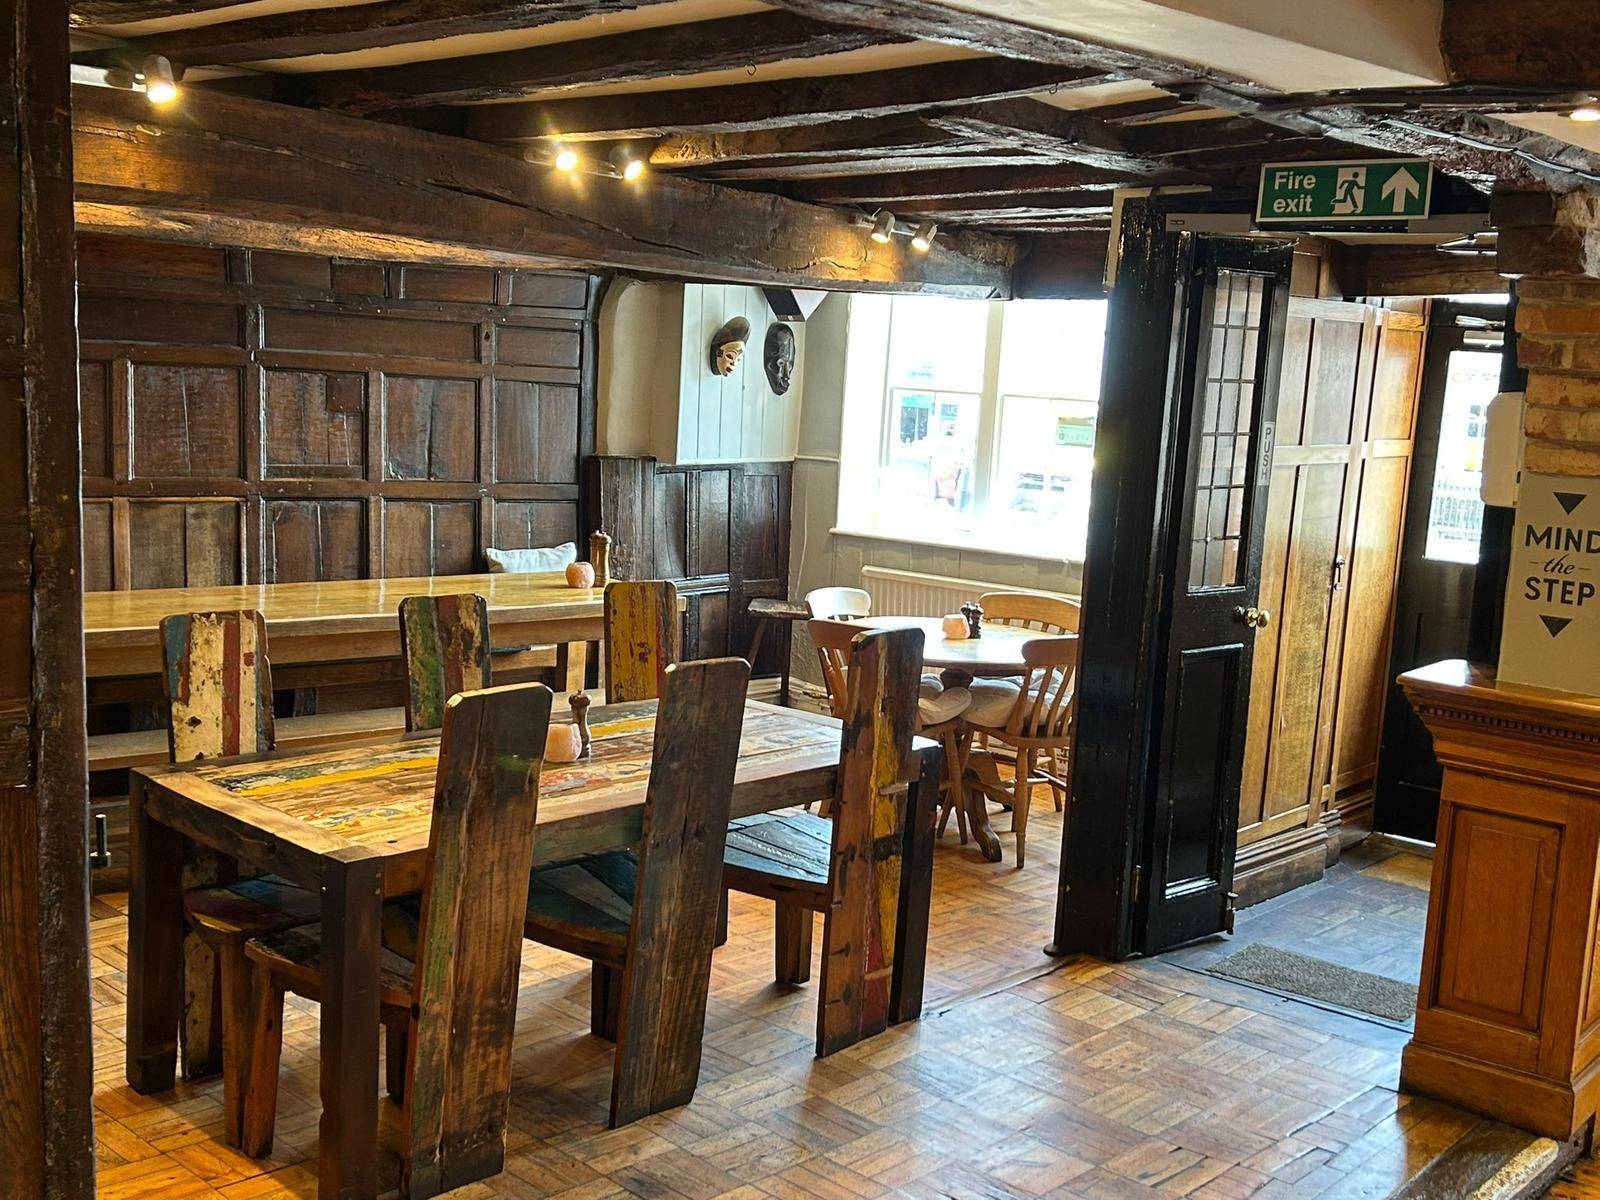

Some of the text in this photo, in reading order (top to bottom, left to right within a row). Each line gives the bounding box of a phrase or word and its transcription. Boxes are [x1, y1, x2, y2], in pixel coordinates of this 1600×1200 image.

[1274, 171, 1316, 190] Fire
[1273, 194, 1313, 212] exit
[1261, 427, 1272, 480] PUSH
[1525, 524, 1600, 554] MIND
[1543, 553, 1575, 575] the
[1524, 576, 1596, 606] STEP
